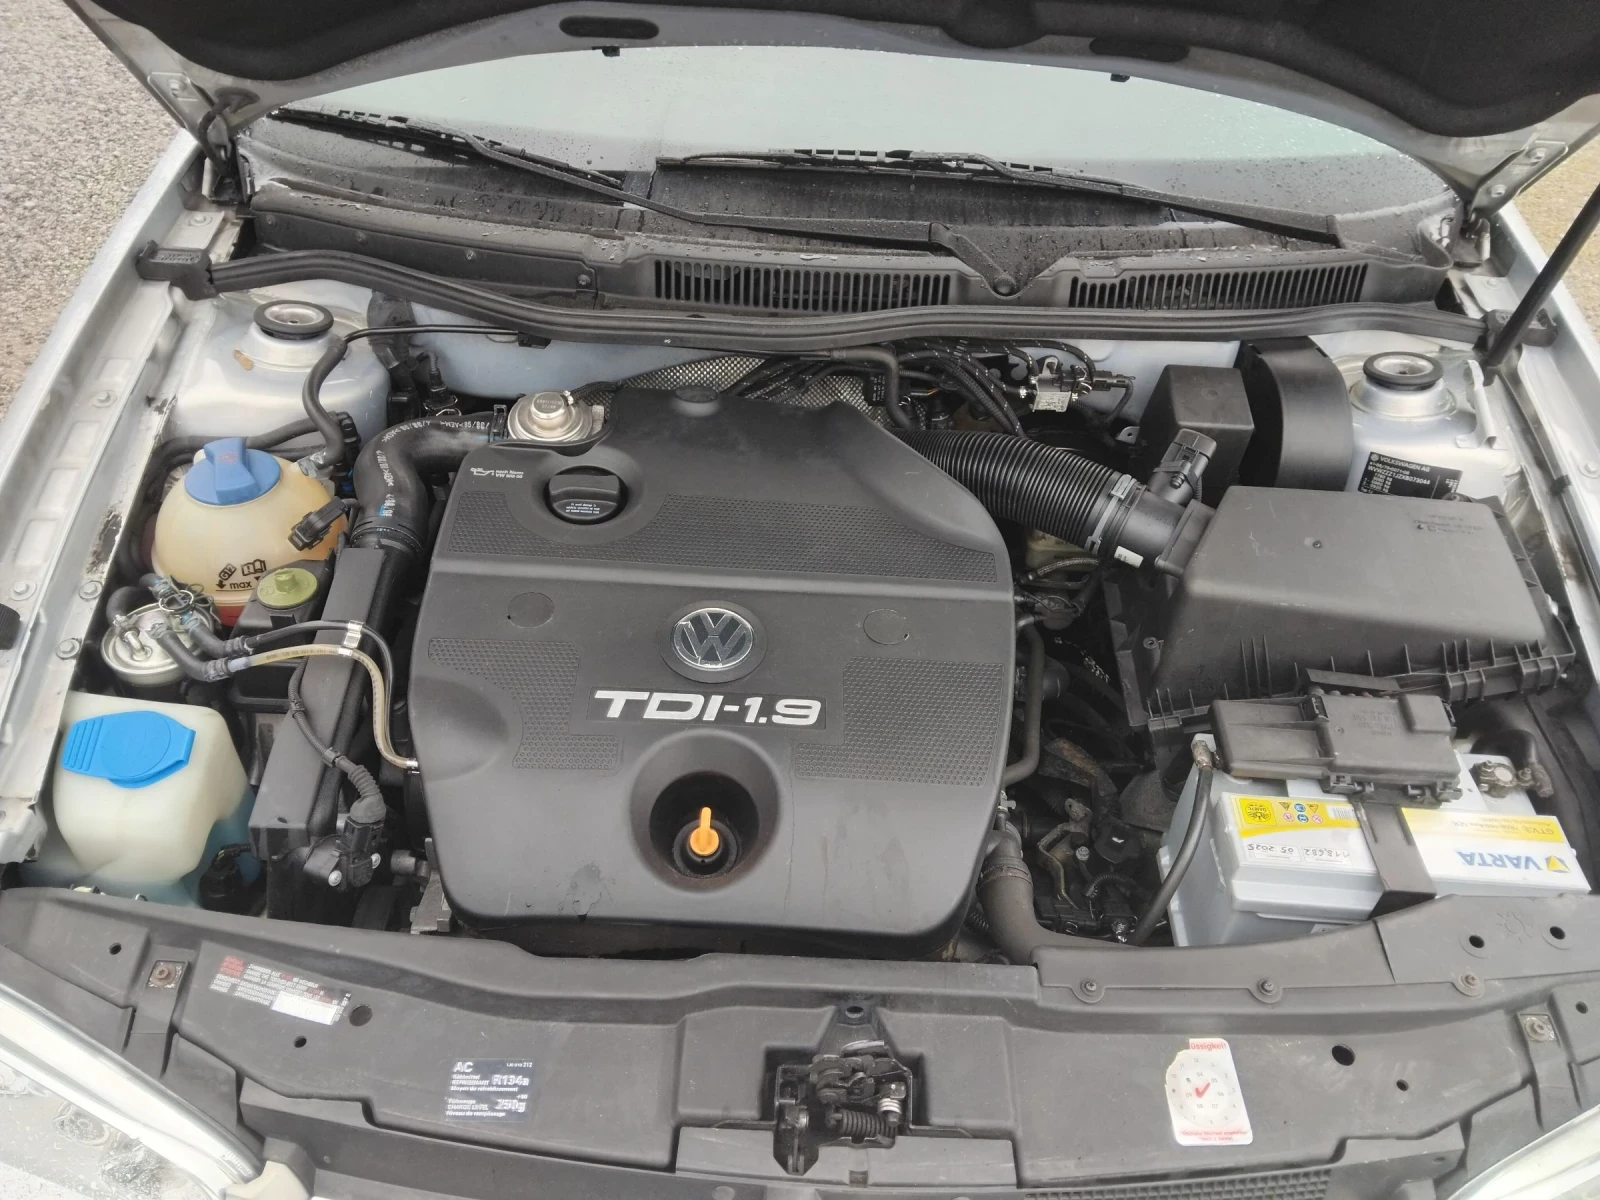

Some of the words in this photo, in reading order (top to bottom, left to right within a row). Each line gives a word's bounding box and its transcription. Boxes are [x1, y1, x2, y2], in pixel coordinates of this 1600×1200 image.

[1380, 456, 1421, 471] VOLKSWAGEN
[229, 581, 252, 589] max
[674, 607, 754, 670] VW
[594, 689, 822, 726] TDI-1.9
[1456, 850, 1544, 871] VARTA
[452, 1061, 474, 1073] AC
[491, 1074, 530, 1086] R134a
